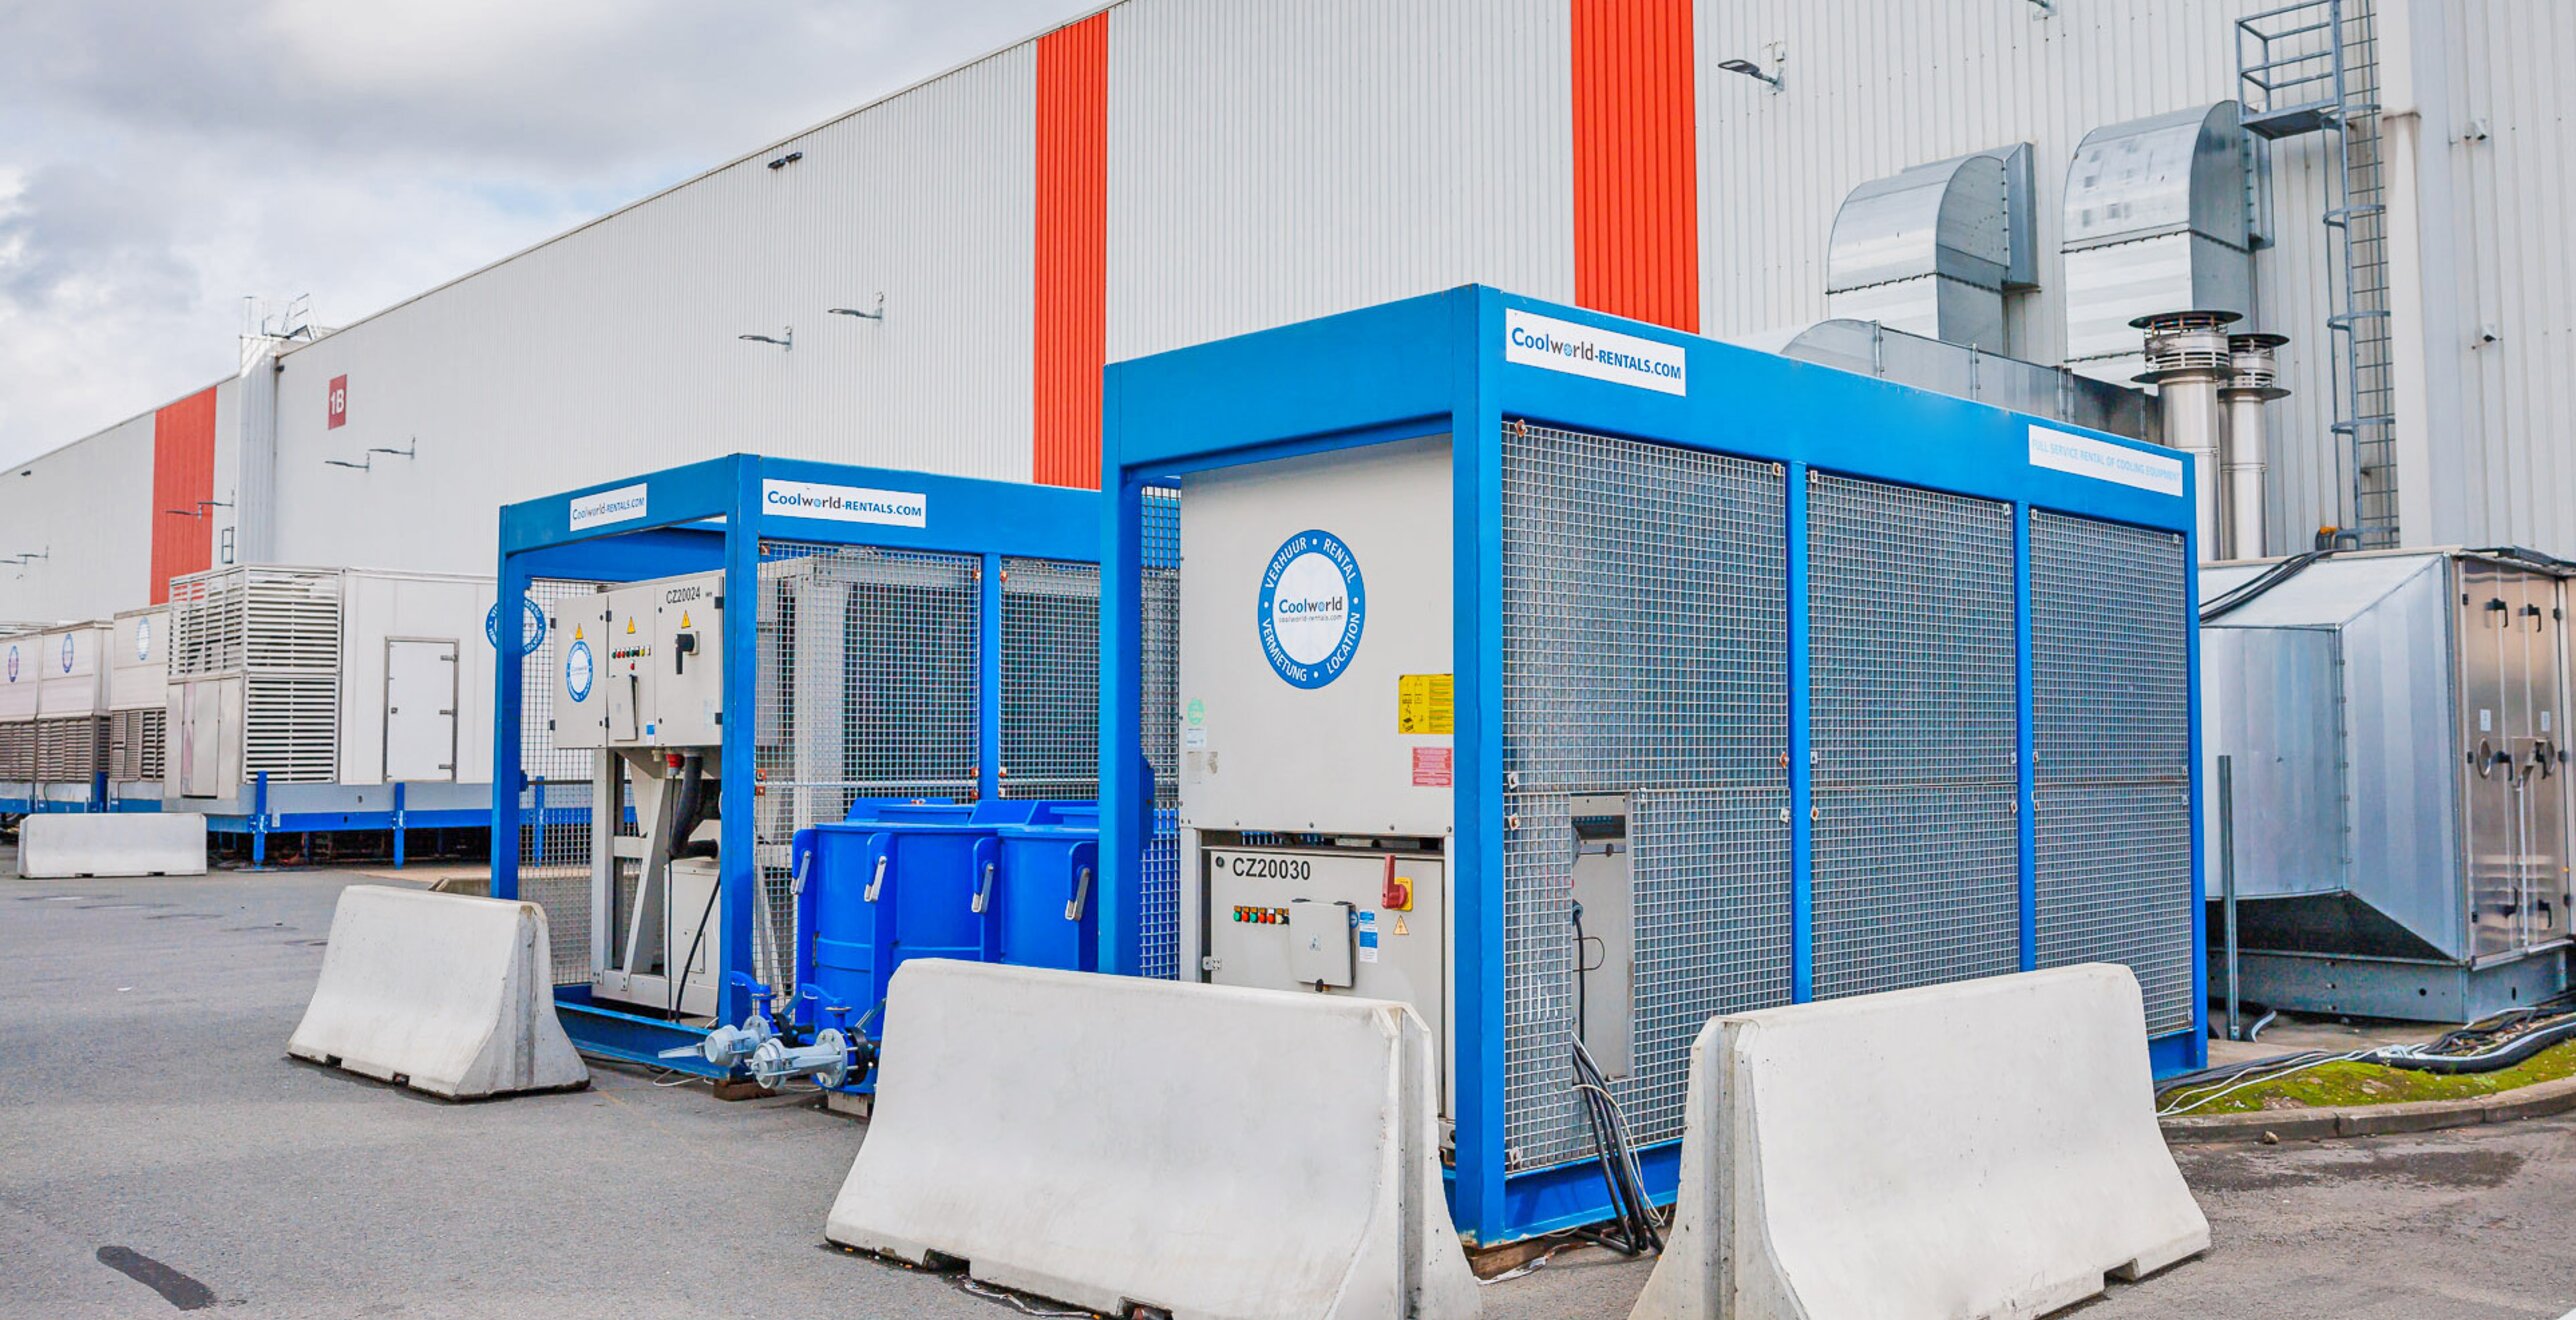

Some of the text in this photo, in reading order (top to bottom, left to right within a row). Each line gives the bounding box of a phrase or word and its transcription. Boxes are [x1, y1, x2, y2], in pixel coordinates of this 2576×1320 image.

[1511, 327, 1682, 380] Coolworld-RENTALS.COM
[330, 388, 345, 415] 1B
[2050, 443, 2078, 460] SERVICE
[2079, 451, 2105, 466] RENTAL
[2116, 459, 2145, 475] COOLING
[767, 490, 922, 517] Coolworld-RENTALS.COM
[1264, 536, 1307, 589] VERHUUR
[1323, 538, 1357, 584] RENTAL
[665, 585, 701, 604] CZ20024
[1278, 596, 1343, 614] Coolworld
[1262, 618, 1307, 682] VERMIETUNG
[1325, 612, 1361, 675] LOCATION
[1232, 857, 1311, 880] CZ20030
